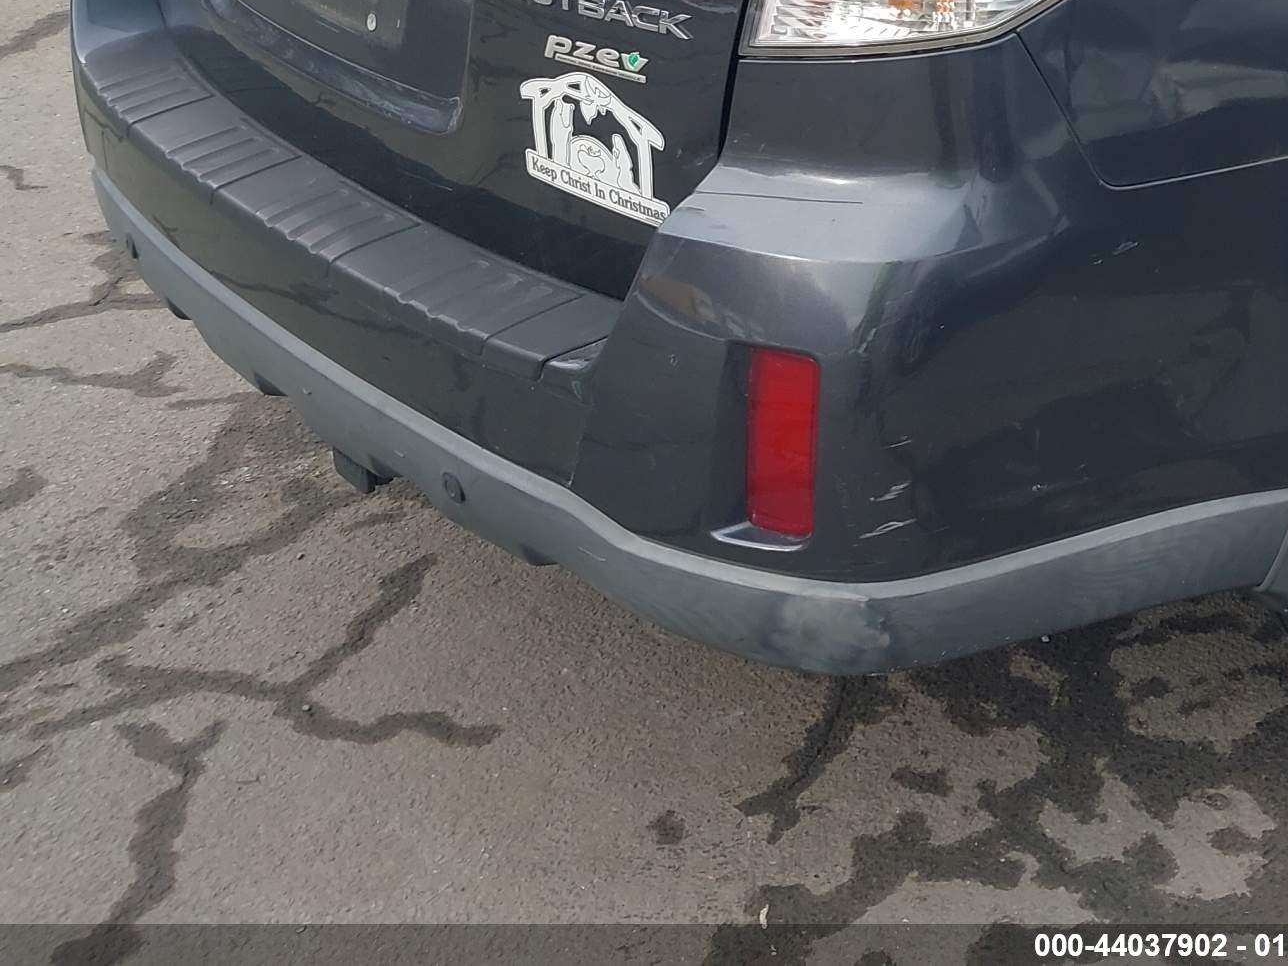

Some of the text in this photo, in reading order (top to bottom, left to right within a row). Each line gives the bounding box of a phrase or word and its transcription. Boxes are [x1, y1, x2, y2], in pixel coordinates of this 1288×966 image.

[544, 34, 649, 72] pzev
[531, 157, 666, 220] Keep Christ In Christmas
